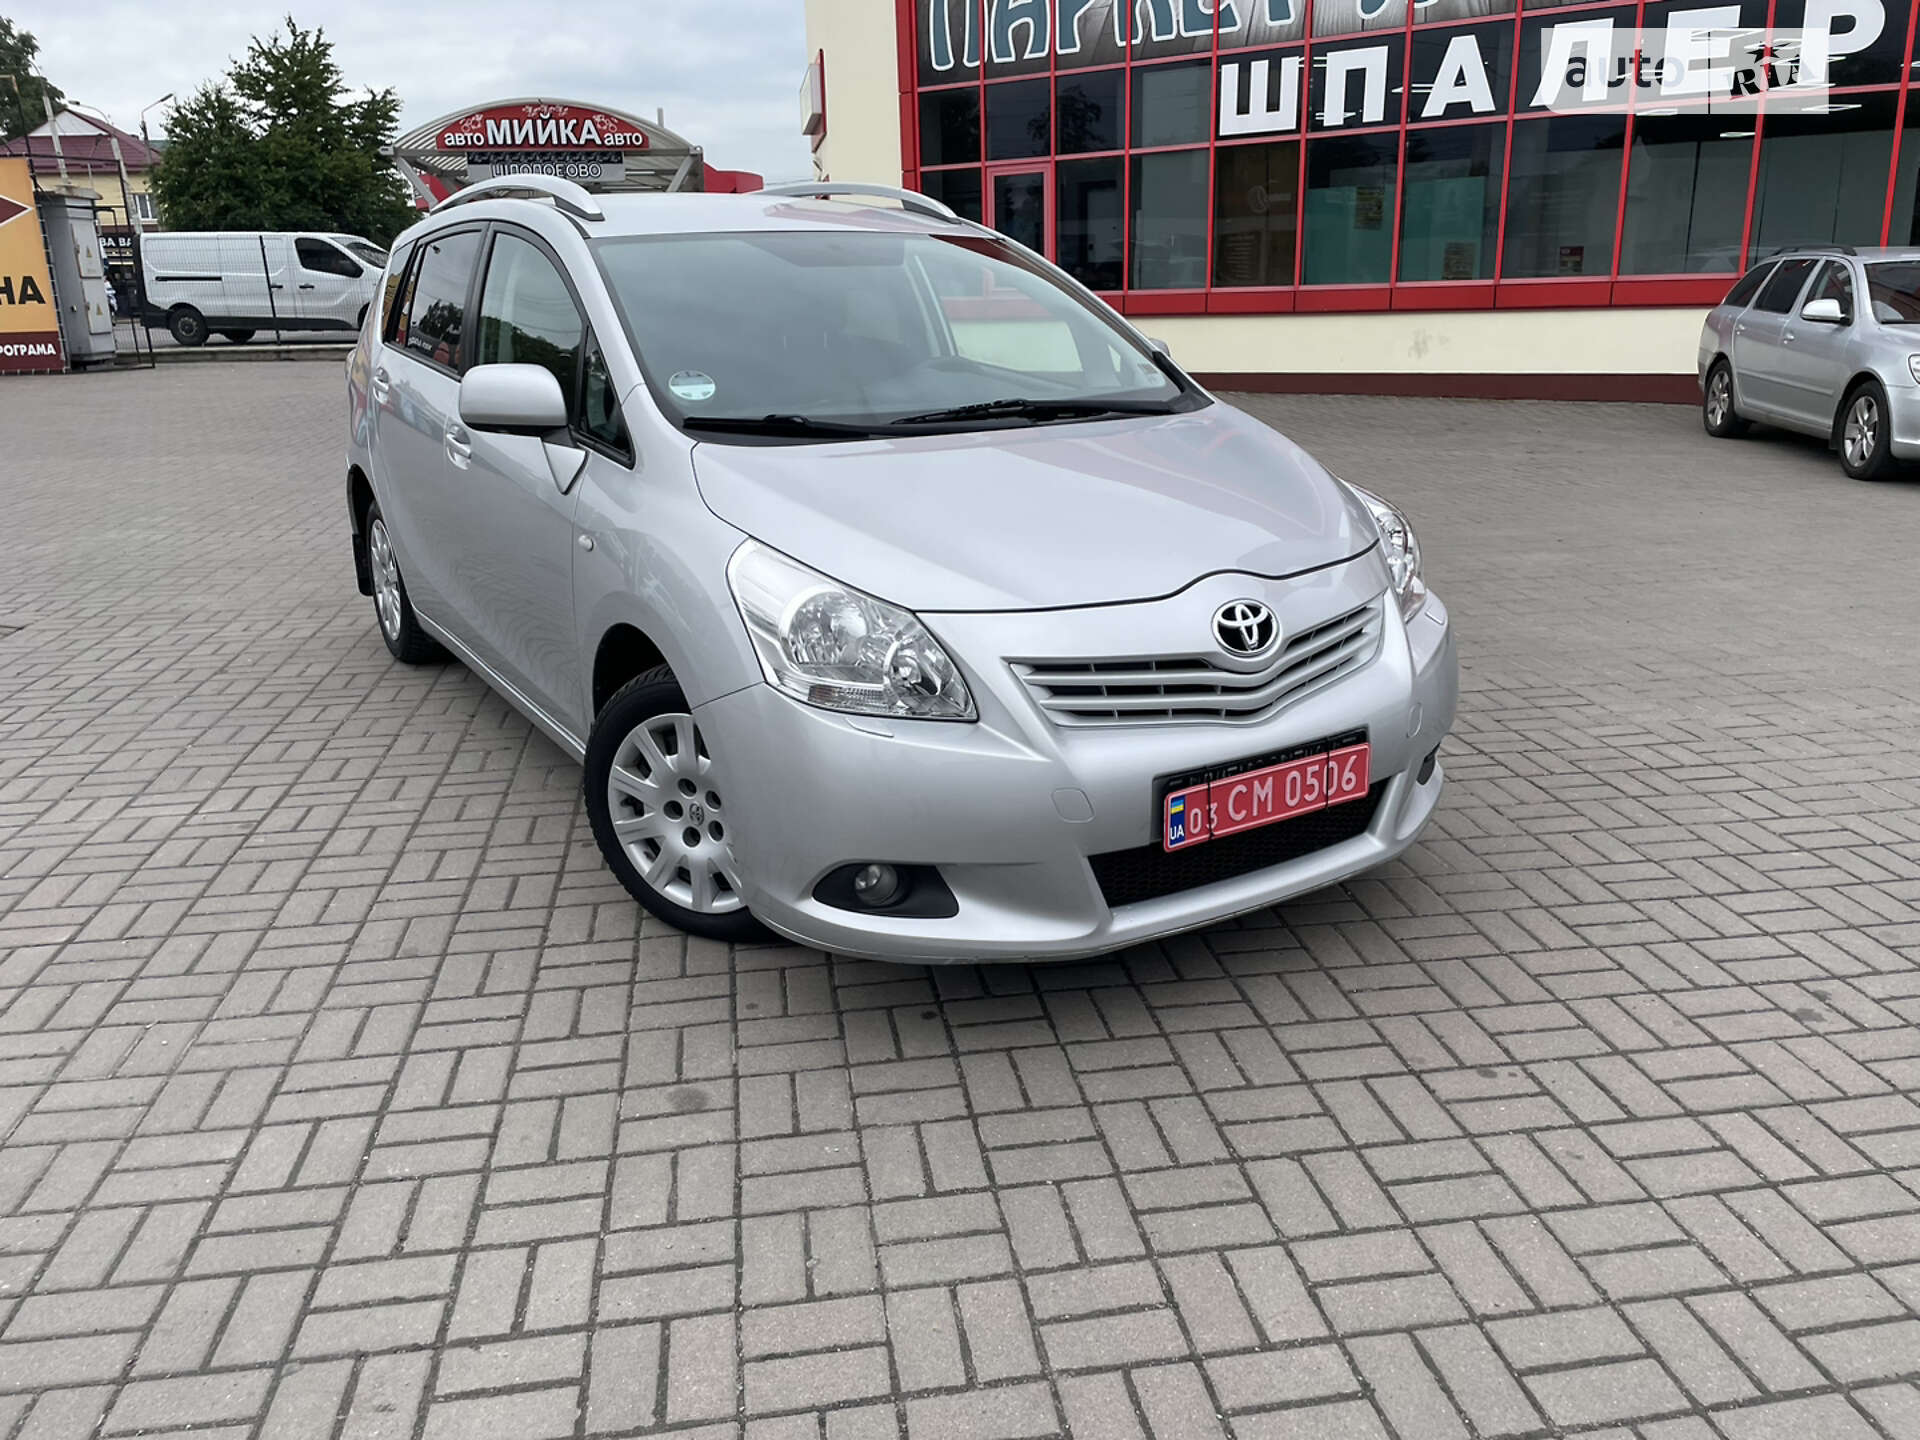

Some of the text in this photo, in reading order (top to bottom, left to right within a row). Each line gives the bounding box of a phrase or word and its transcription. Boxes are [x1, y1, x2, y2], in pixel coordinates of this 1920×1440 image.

[929, 0, 1294, 71] ПАР
[444, 112, 643, 146] авто МИЙКА авто
[1189, 801, 1218, 834] 03
[1227, 777, 1273, 822] CM
[1284, 754, 1359, 808] 0506
[1169, 825, 1185, 841] UA
